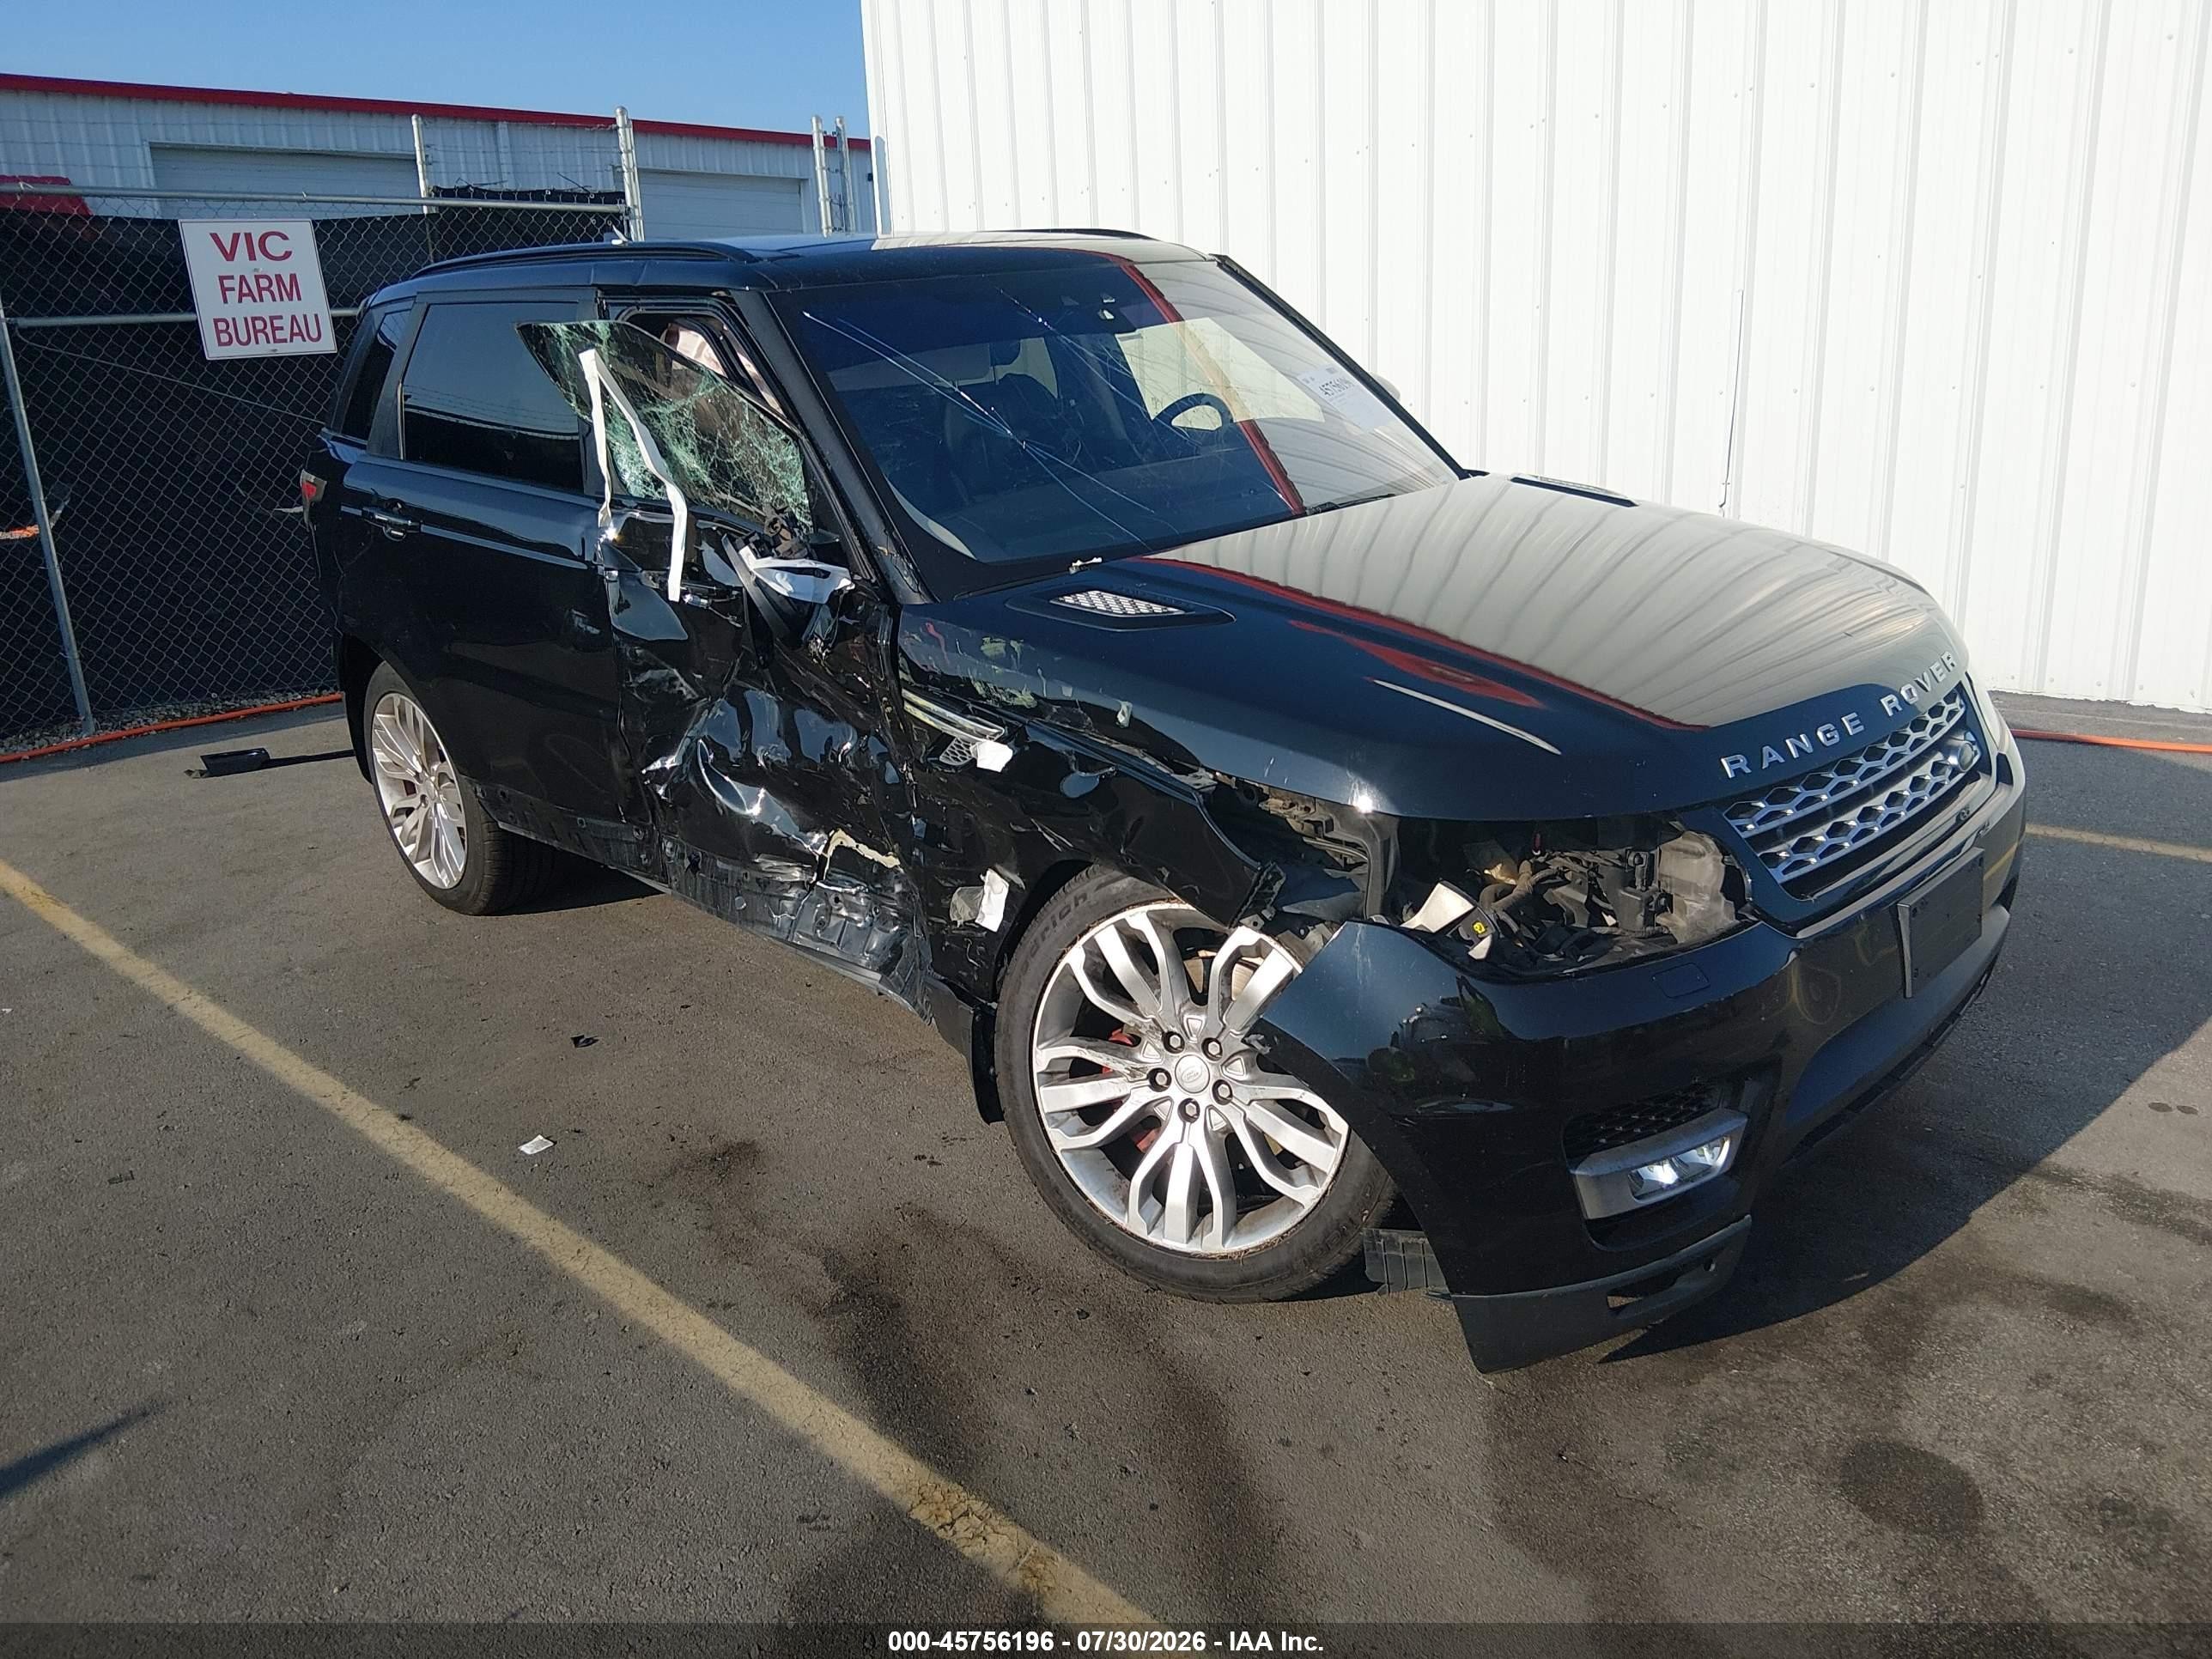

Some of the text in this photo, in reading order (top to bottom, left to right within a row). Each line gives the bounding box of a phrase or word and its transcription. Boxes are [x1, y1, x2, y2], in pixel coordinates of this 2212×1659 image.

[209, 230, 293, 262] VIC
[217, 272, 302, 304] FARM
[212, 313, 322, 348] BUREAU
[1720, 650, 1957, 779] RANGE ROVER
